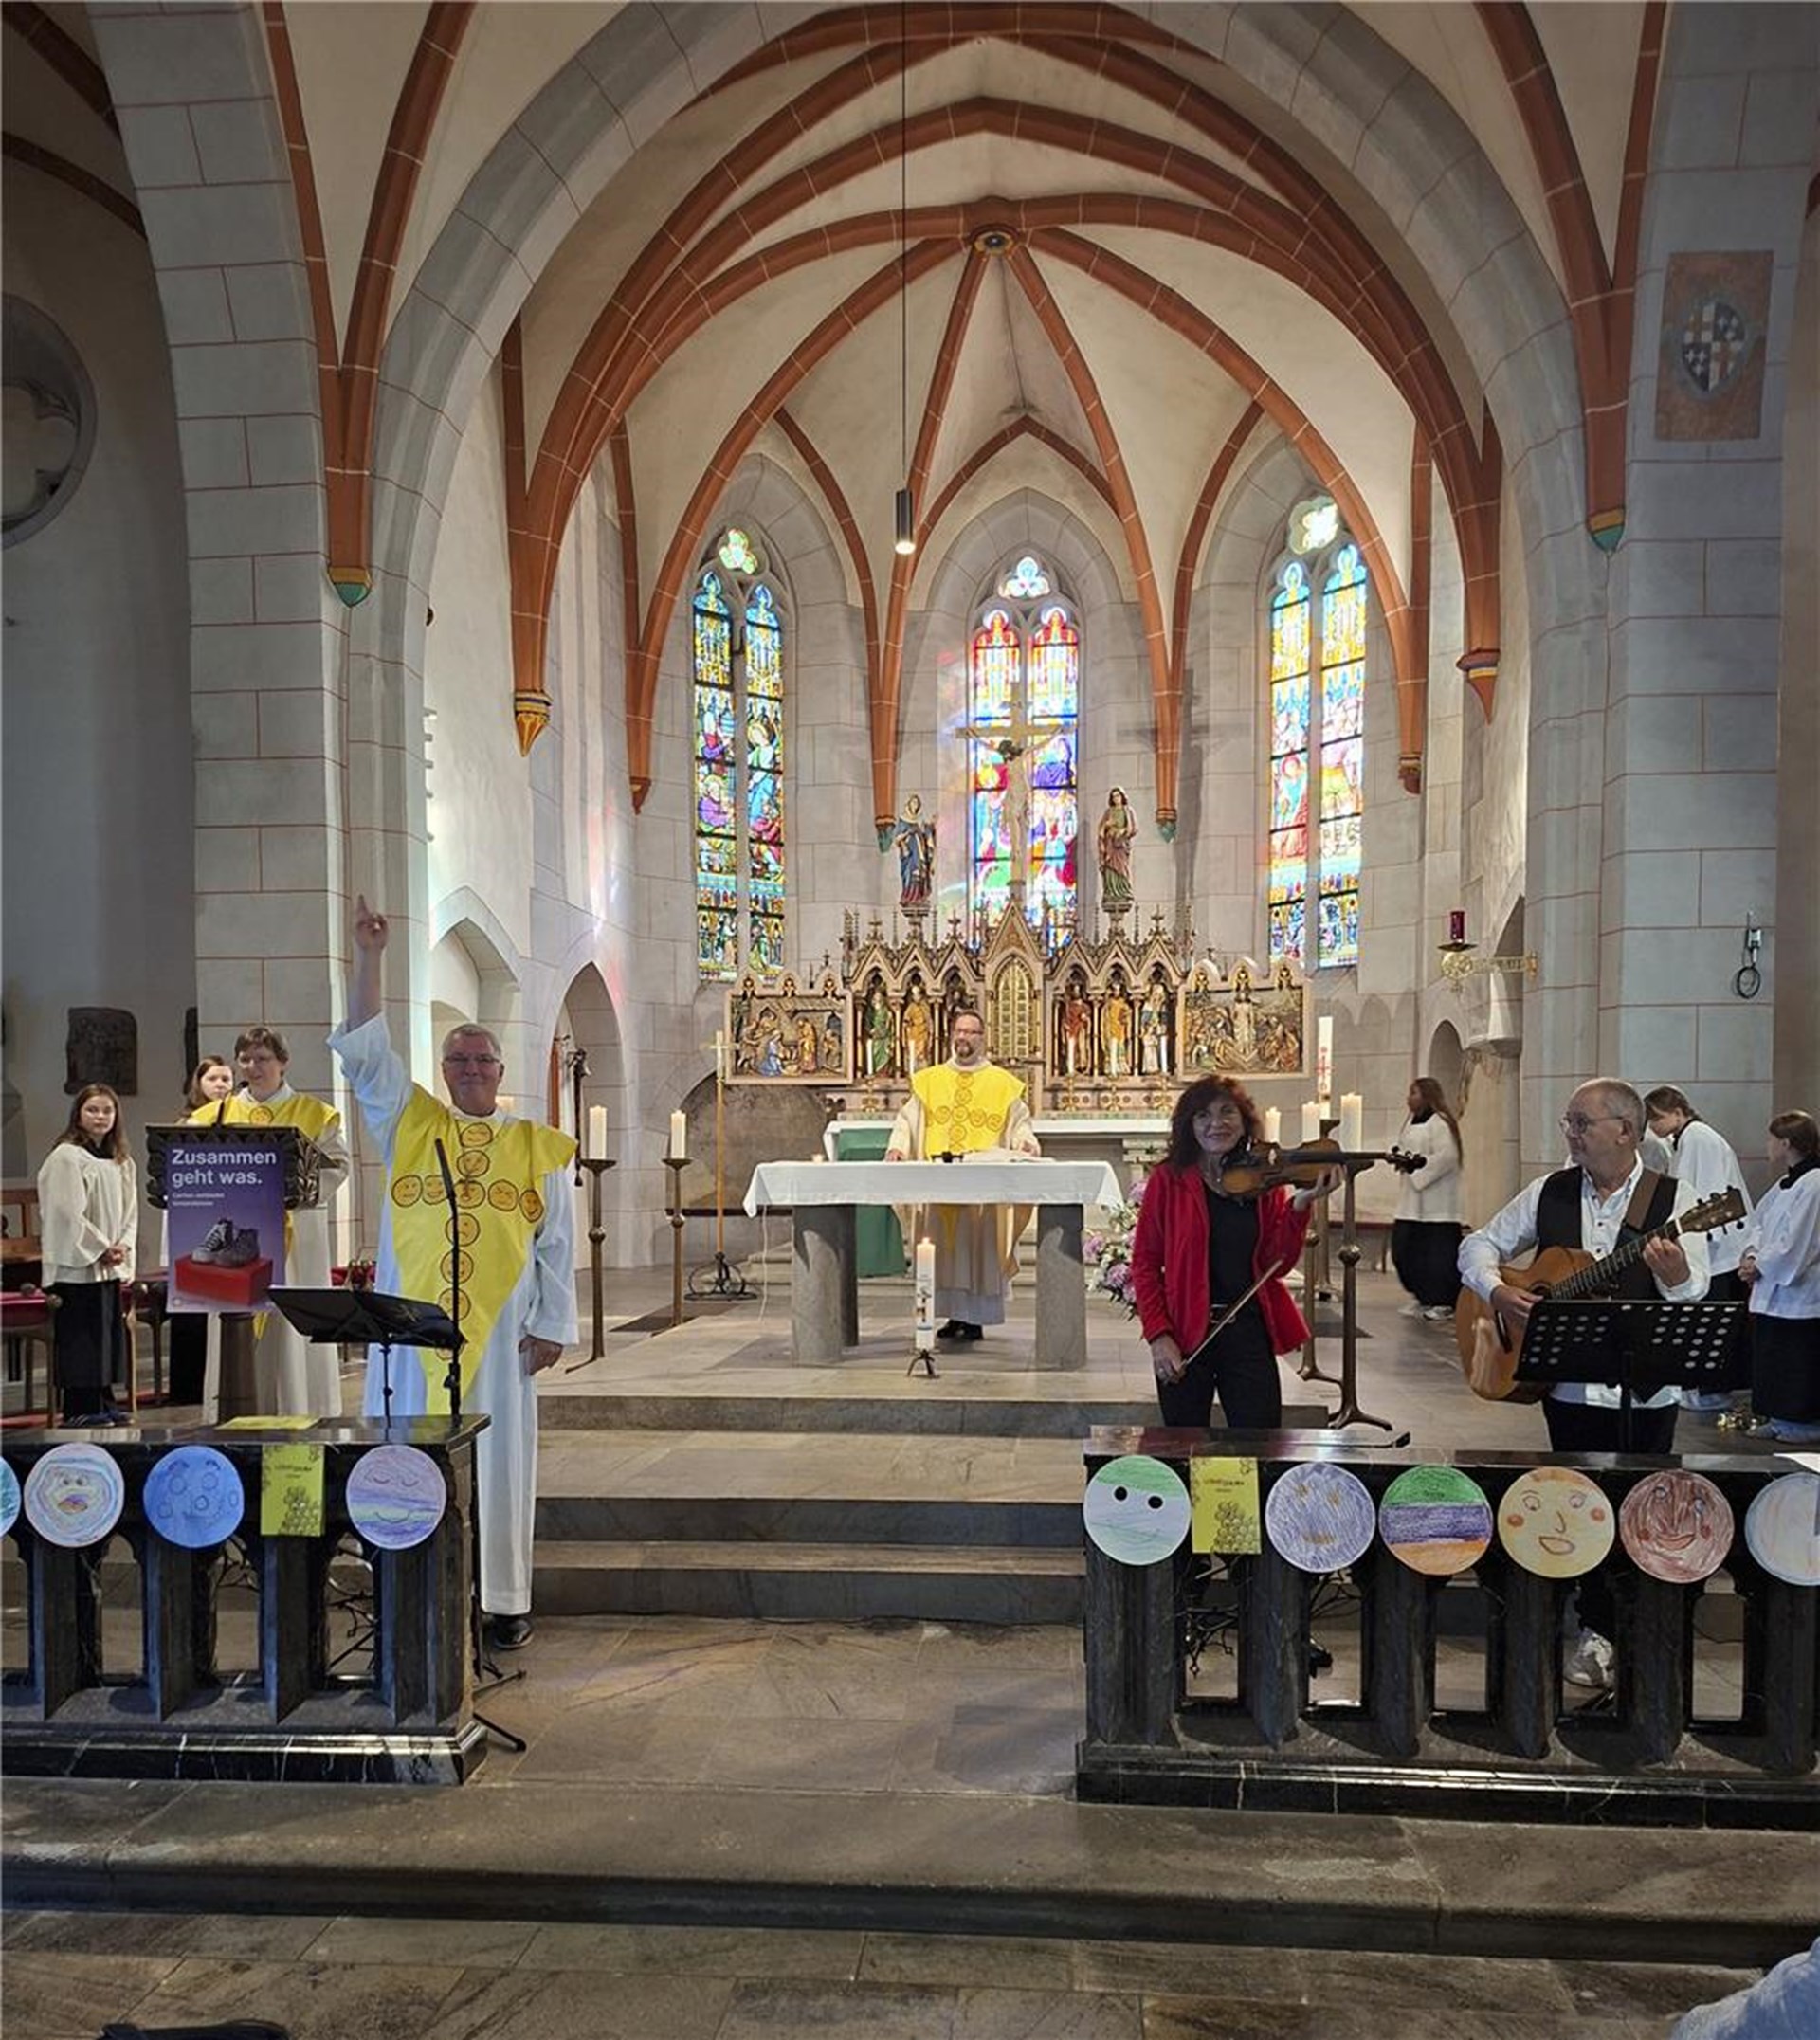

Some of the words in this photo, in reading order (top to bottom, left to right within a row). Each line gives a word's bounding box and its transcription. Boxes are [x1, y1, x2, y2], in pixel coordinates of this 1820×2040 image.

[172, 1149, 277, 1165] Zusammen
[172, 1169, 213, 1189] geht
[219, 1172, 263, 1184] was.
